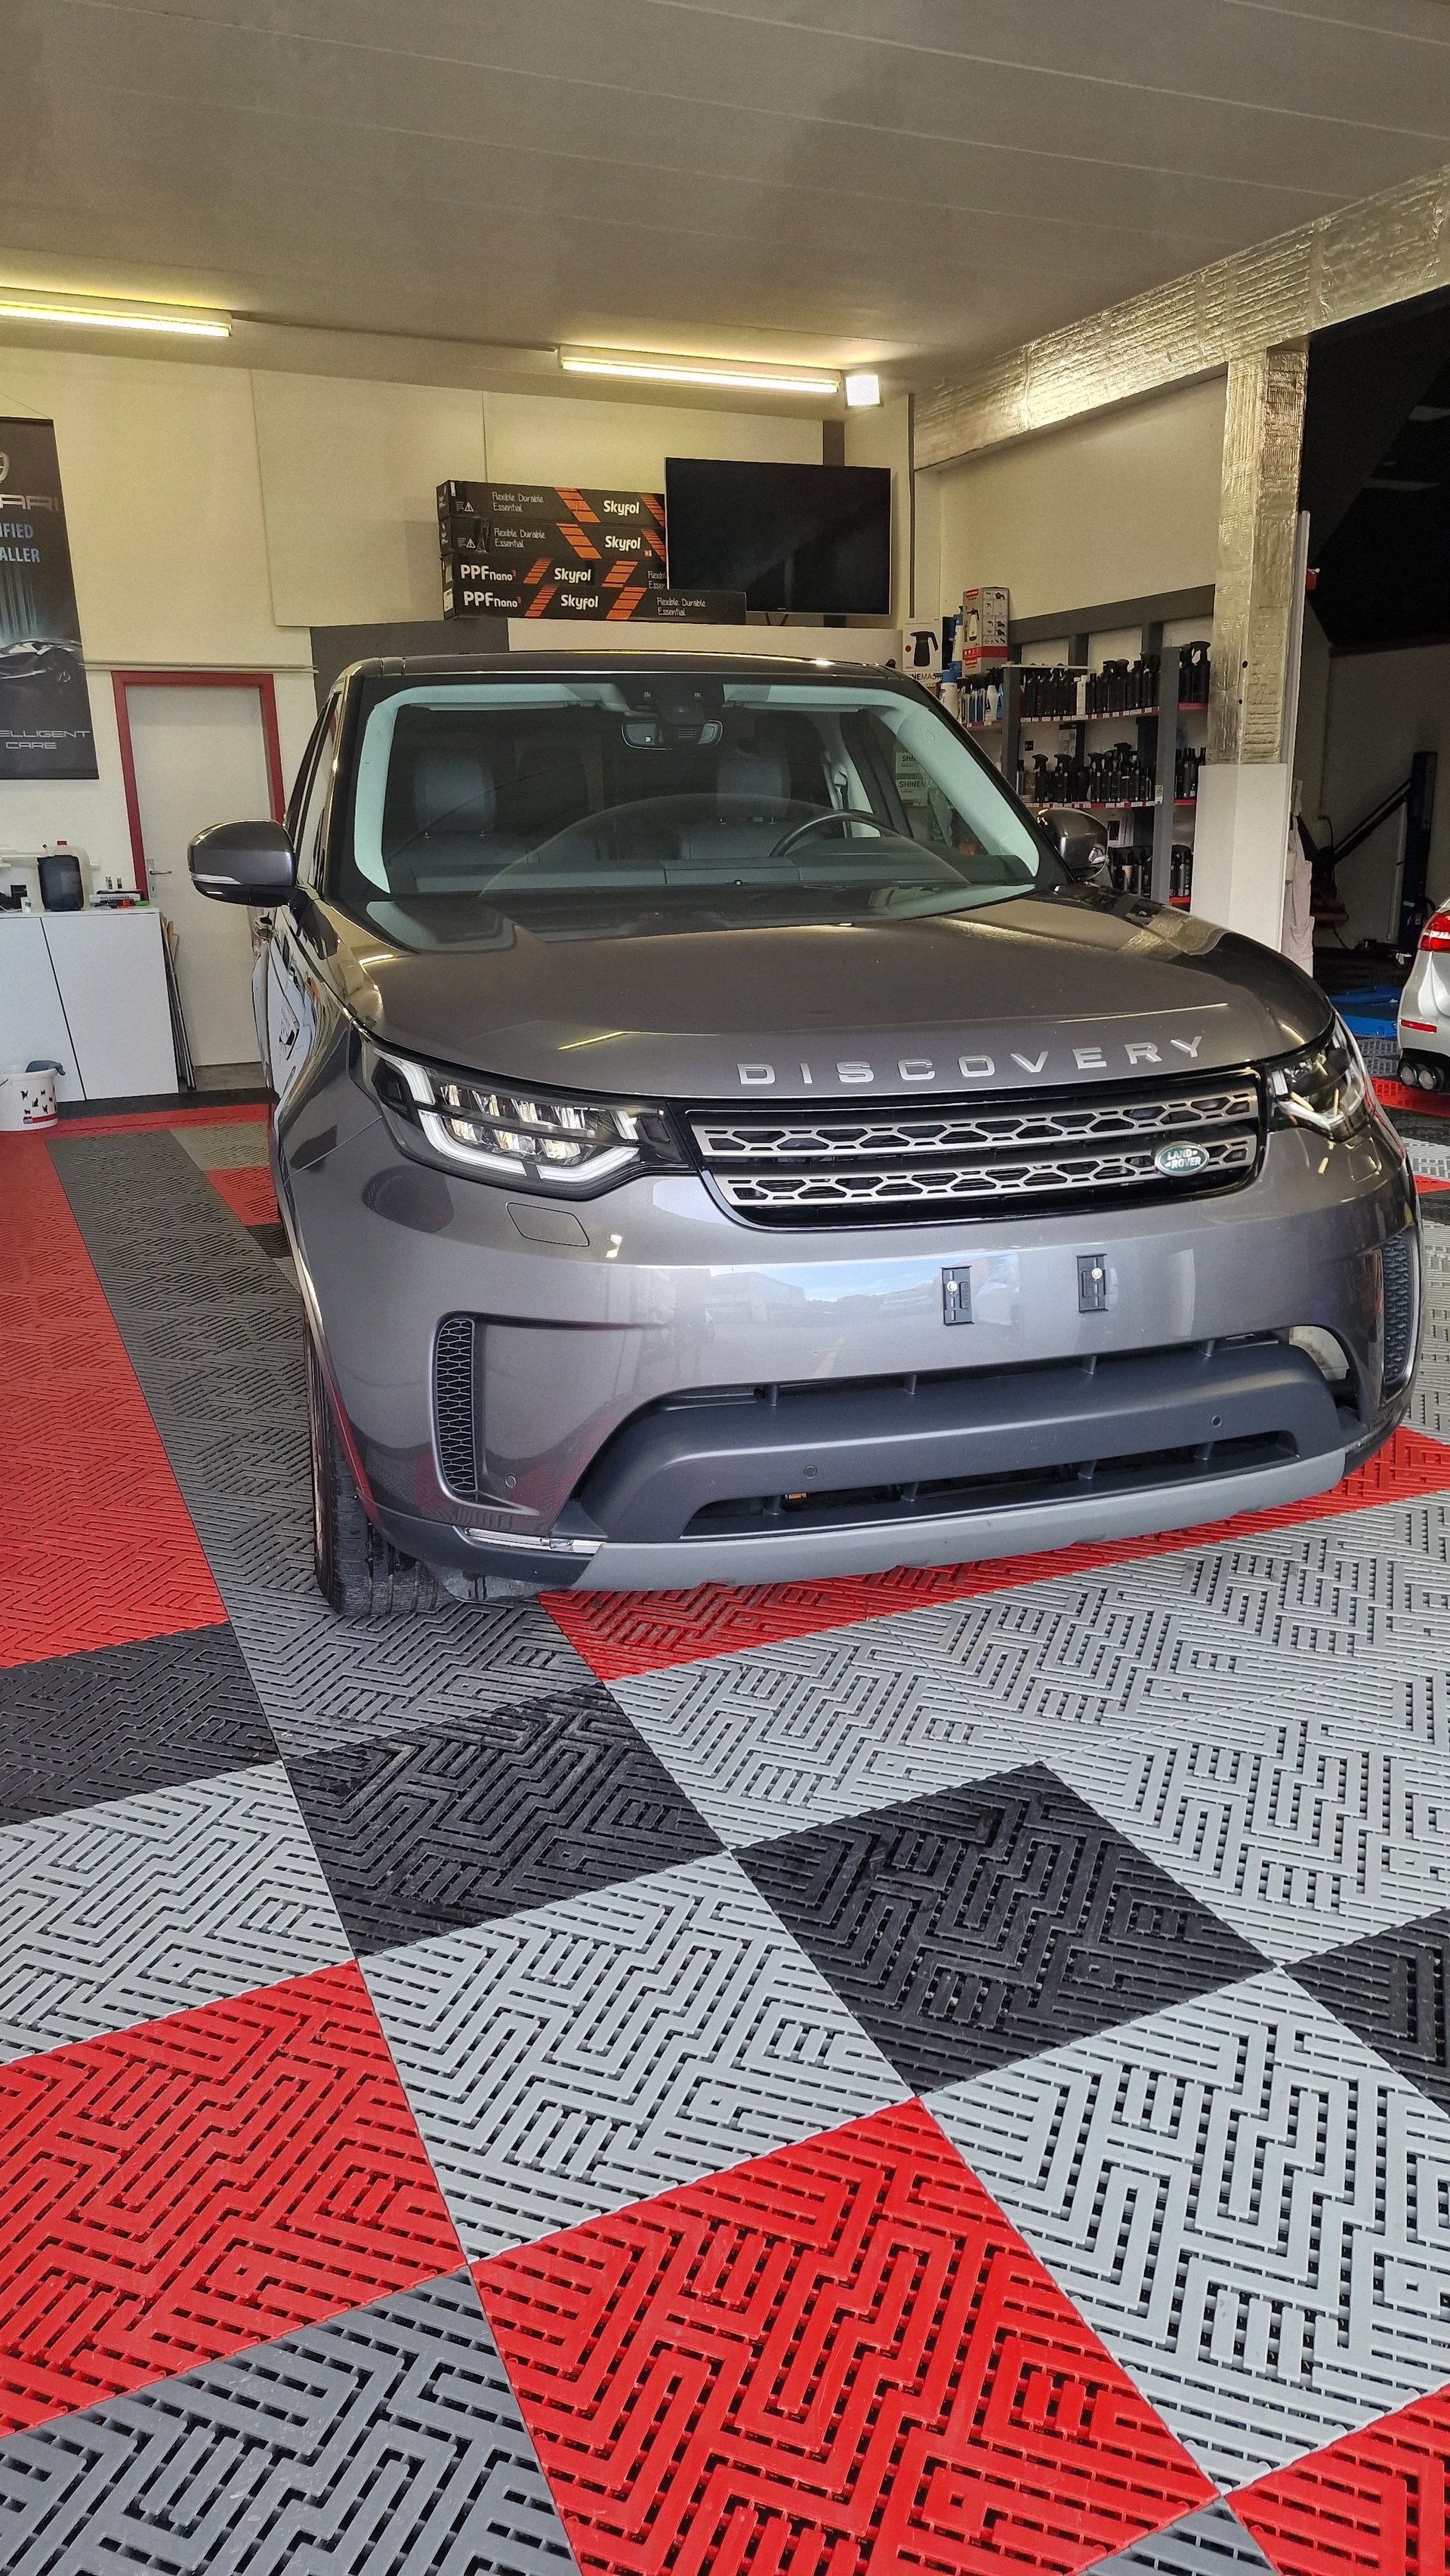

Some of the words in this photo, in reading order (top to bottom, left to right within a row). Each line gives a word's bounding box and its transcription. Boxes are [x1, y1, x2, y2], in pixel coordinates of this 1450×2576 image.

[492, 492, 516, 502] Flexible
[518, 493, 544, 503] Durable
[493, 502, 523, 512] Essential
[603, 500, 640, 516] Skyfol
[494, 528, 518, 538] Flexible
[520, 530, 546, 539] Durable
[495, 539, 524, 548] Essential
[605, 536, 641, 551] Skyfol
[554, 568, 591, 584] Skyfol
[560, 595, 599, 610] Skyfol
[656, 597, 680, 607] Flexible
[681, 598, 707, 607] Durable
[658, 607, 686, 616] Essential
[736, 1036, 1203, 1086] DISCOVERY
[1167, 1148, 1192, 1161] LAND
[1171, 1156, 1202, 1169] ROVER
